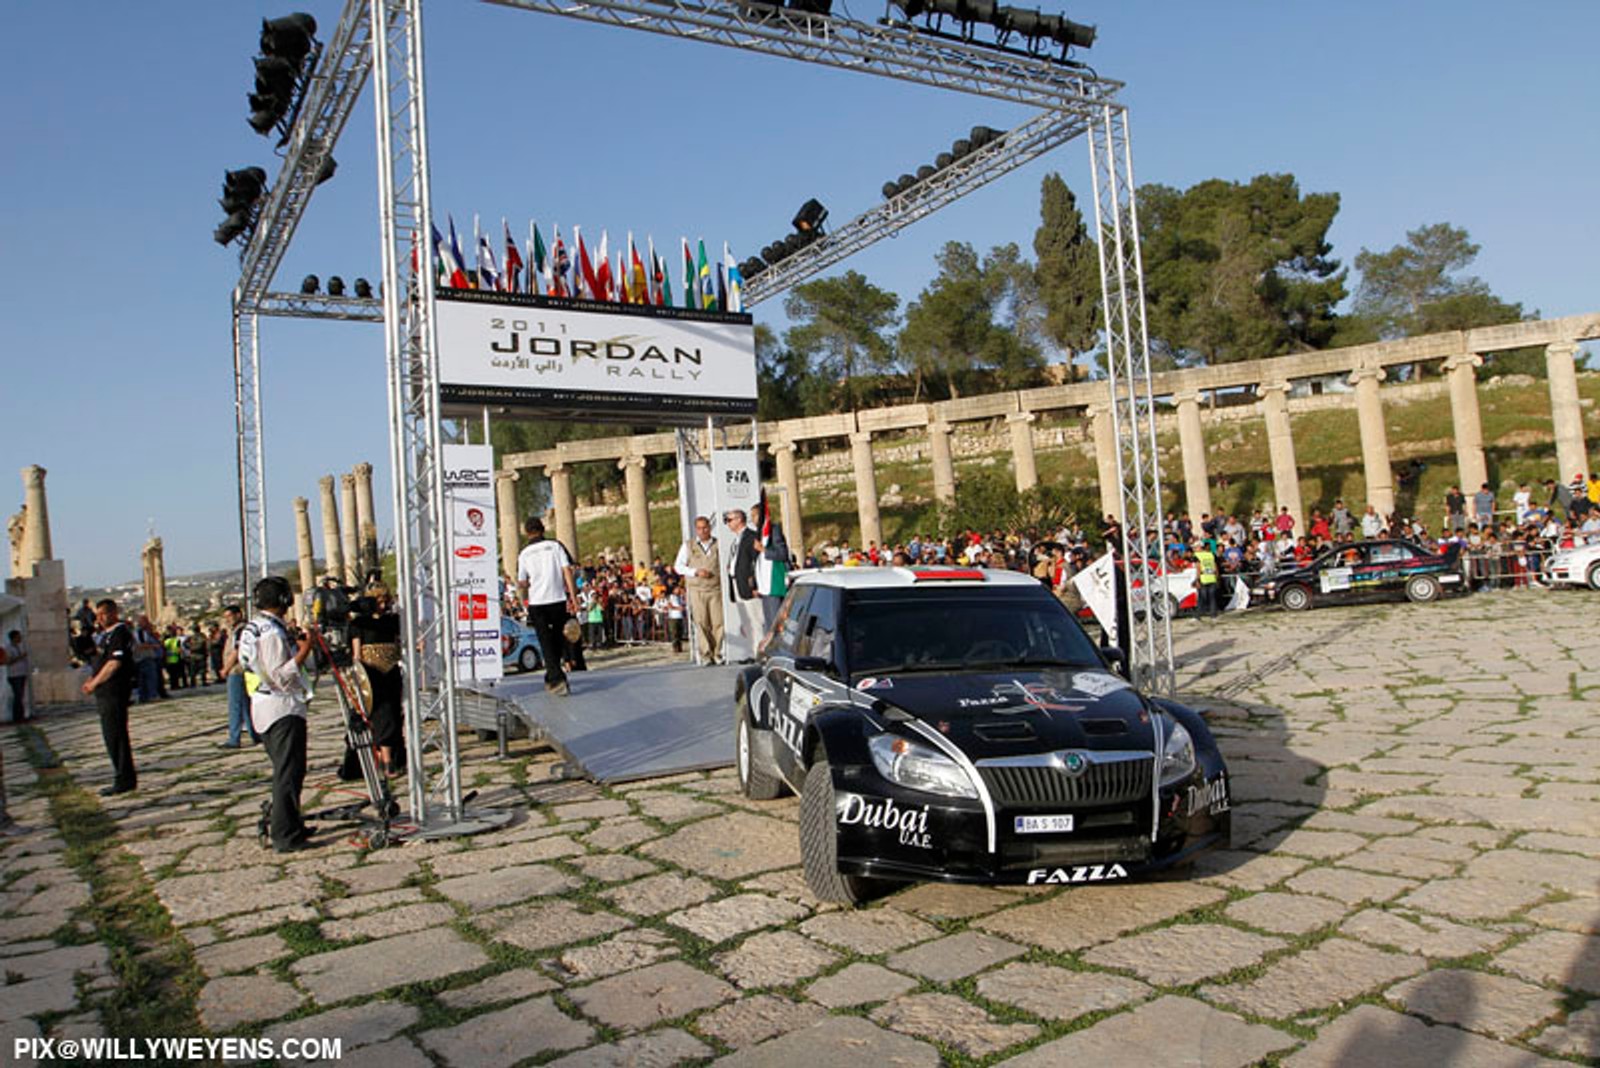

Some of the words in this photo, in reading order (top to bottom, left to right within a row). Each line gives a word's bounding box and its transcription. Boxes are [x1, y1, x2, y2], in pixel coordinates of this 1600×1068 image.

[491, 318, 567, 335] 2011
[491, 332, 703, 366] JORDAN
[535, 359, 564, 375] رالي
[606, 365, 703, 381] RALLY
[725, 470, 750, 483] FIA
[838, 793, 930, 834] Dubai
[1026, 818, 1040, 830] BA
[1042, 818, 1049, 829] S
[1052, 818, 1071, 829] 107
[1026, 863, 1128, 885] FAZZA
